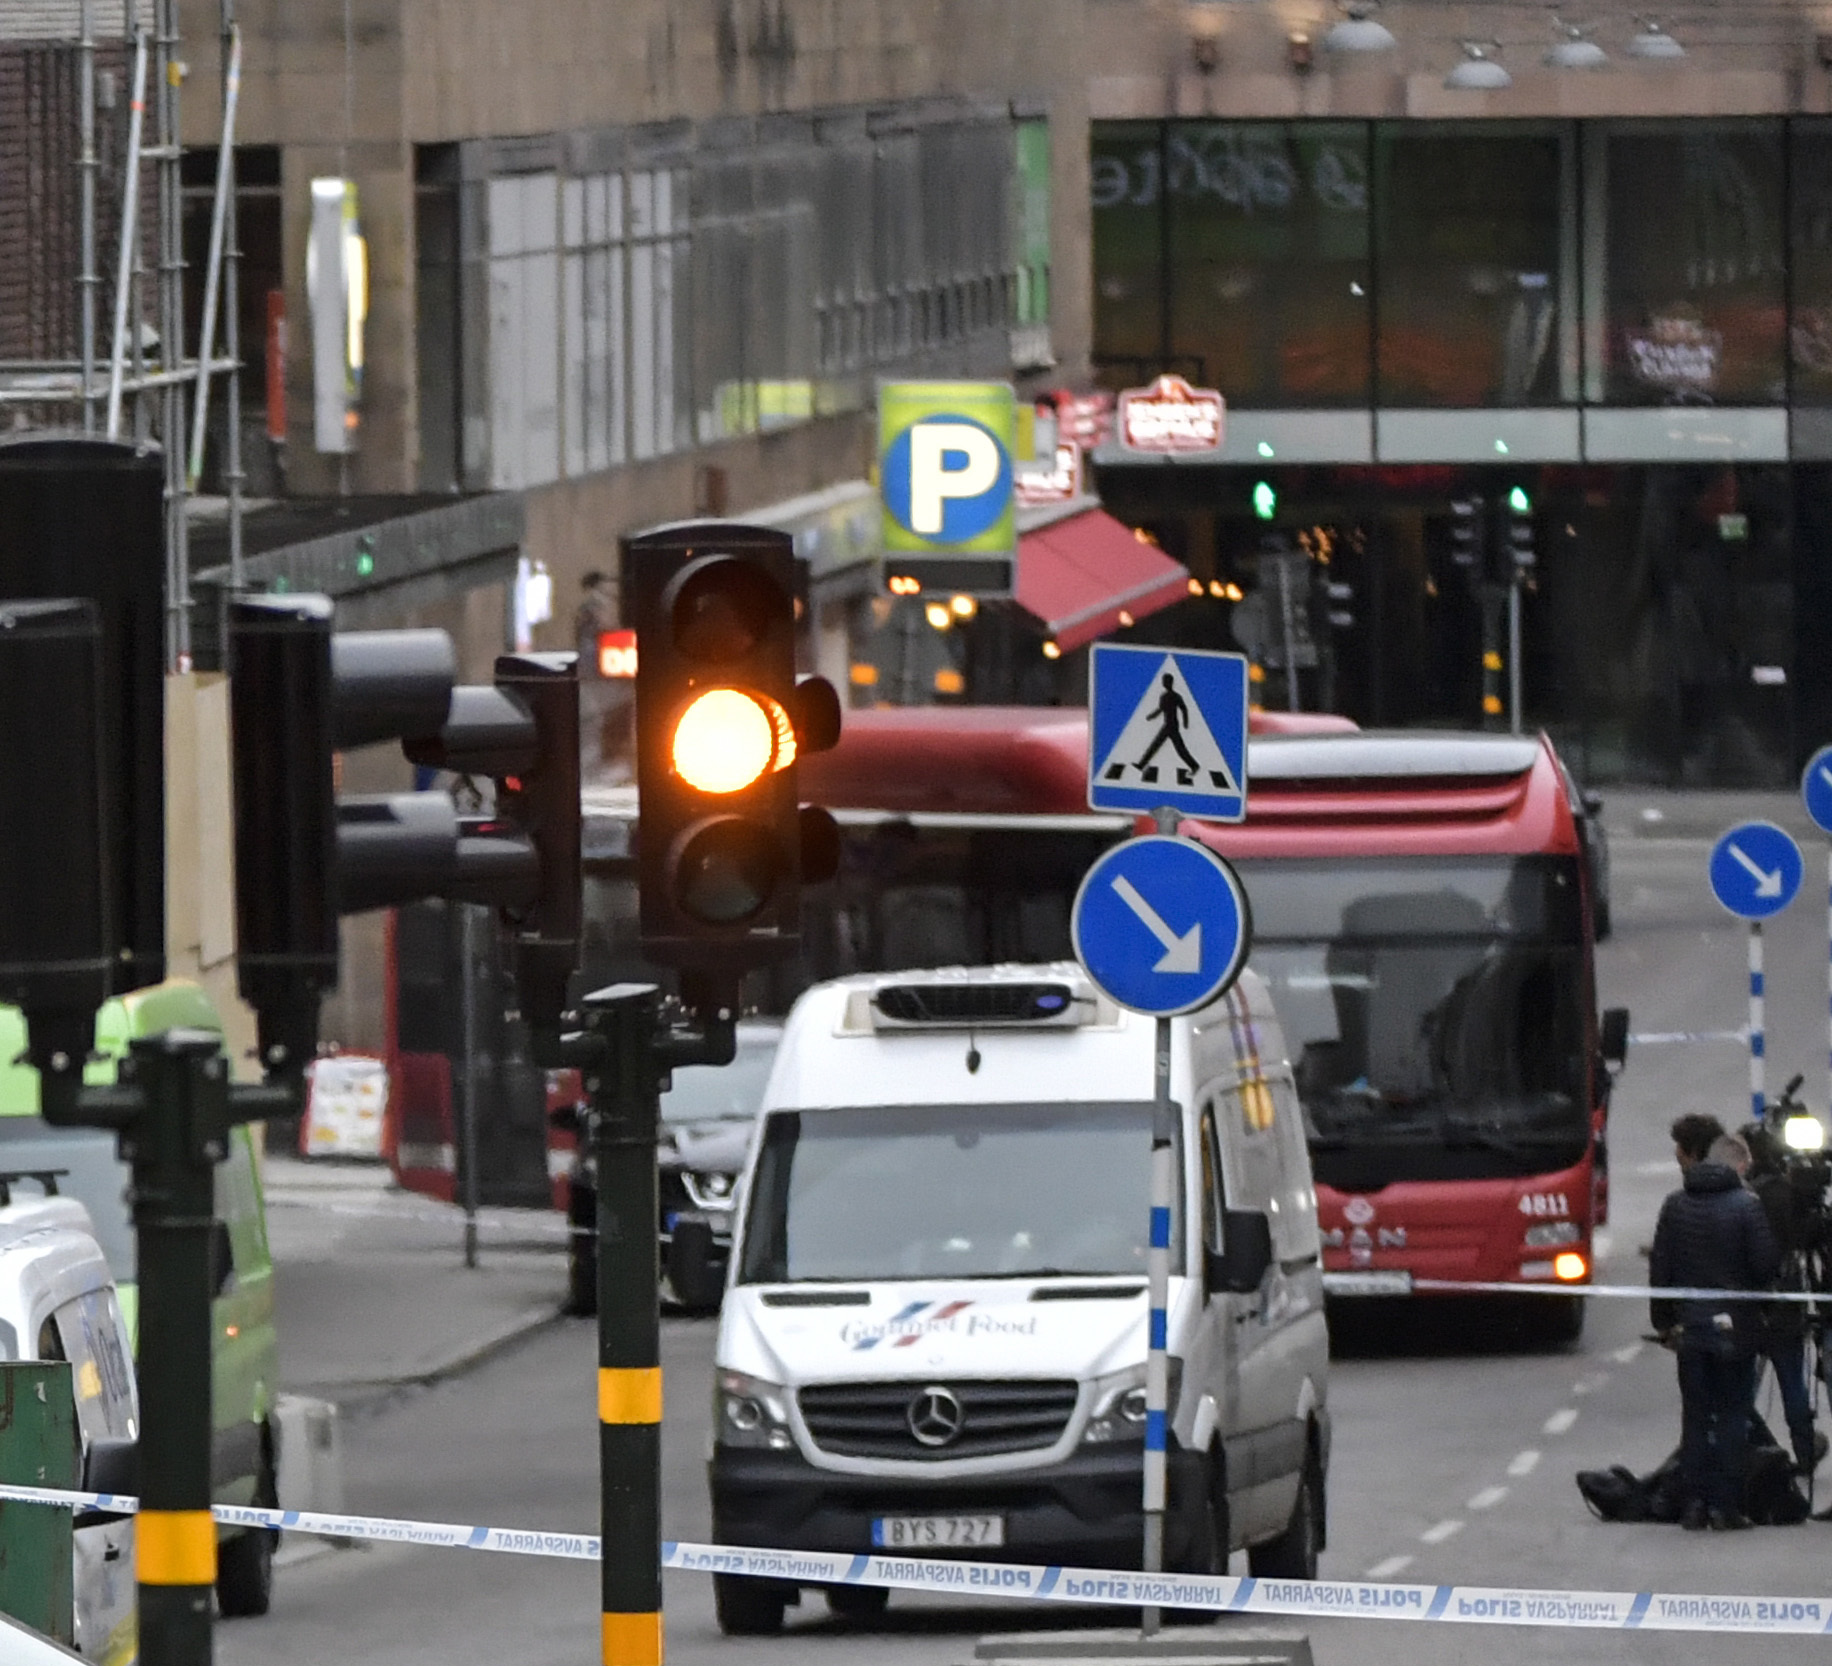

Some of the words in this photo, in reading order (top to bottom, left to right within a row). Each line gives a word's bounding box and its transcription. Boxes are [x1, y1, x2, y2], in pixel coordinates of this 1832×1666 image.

[911, 424, 1000, 534] P
[1518, 1193, 1569, 1216] 4811
[945, 1520, 990, 1542] 727
